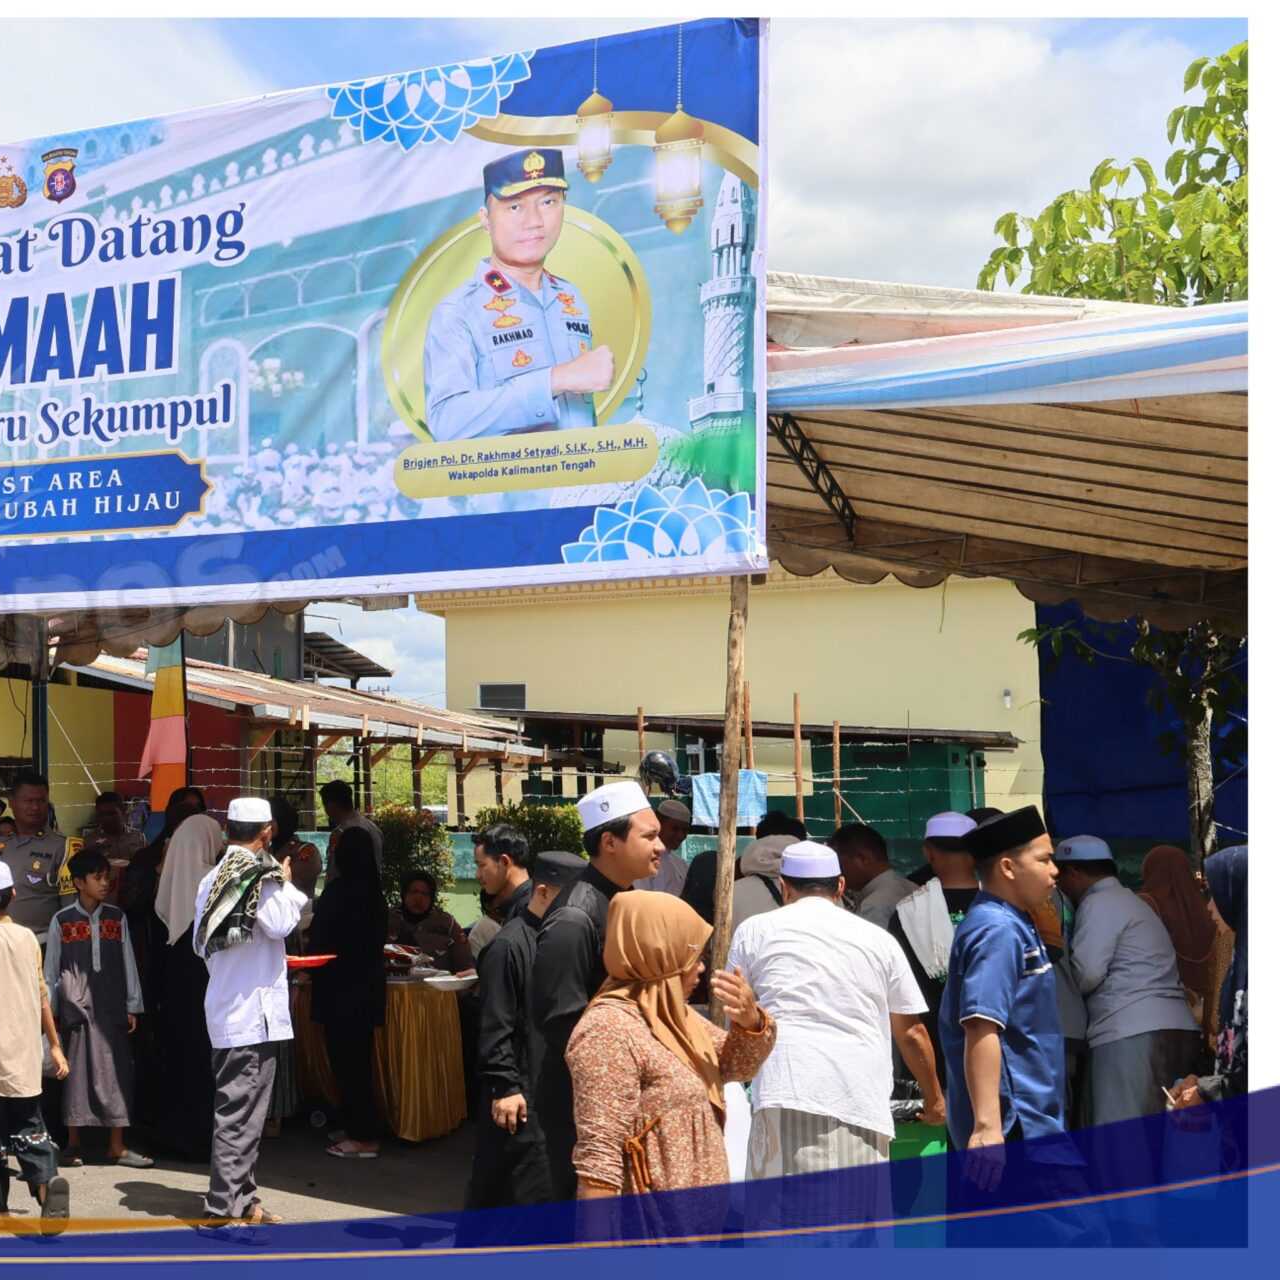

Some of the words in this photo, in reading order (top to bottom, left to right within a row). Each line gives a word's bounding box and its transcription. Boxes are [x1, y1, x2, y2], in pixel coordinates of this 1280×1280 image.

[48, 201, 247, 269] Datang
[492, 328, 534, 347] RAKHMAD
[37, 383, 232, 446] Sekumpul
[403, 458, 439, 470] Brigjen
[460, 453, 475, 465] Dr.
[477, 449, 522, 462] Rakhmad
[523, 446, 563, 460] Setyadi,
[623, 437, 648, 449] M.H.
[47, 468, 124, 492] AREA
[448, 468, 499, 481] Wakapolda
[501, 463, 558, 477] Kalimantan
[560, 458, 596, 472] Tengah
[94, 490, 182, 515] HIJAU
